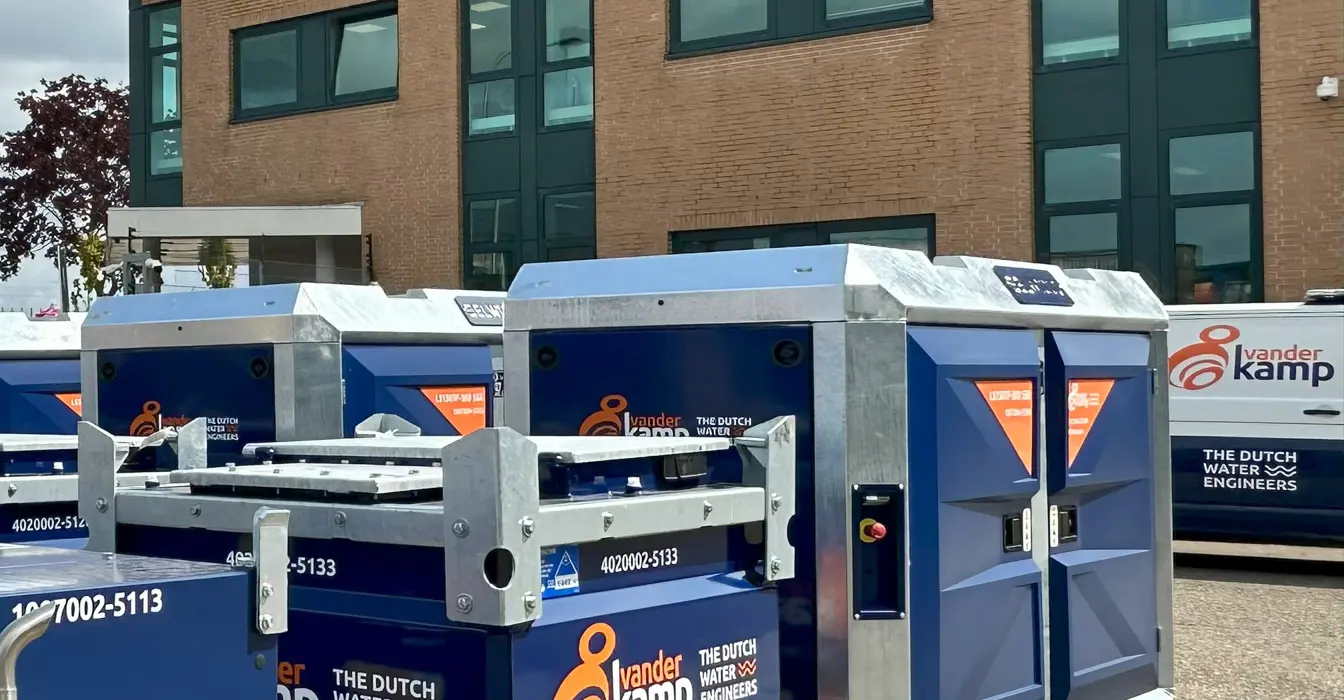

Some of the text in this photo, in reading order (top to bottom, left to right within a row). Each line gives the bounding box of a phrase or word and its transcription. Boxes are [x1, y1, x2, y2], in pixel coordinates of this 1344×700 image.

[462, 303, 504, 319] SELW
[1245, 344, 1324, 361] vander
[1234, 344, 1335, 387] kamp
[631, 412, 682, 428] vander
[696, 416, 752, 427] THE DUTCH
[697, 426, 731, 437] WATER
[1202, 449, 1297, 463] THE DUTCH
[1203, 462, 1260, 475] WATER
[1203, 476, 1297, 491] ENGINEERS
[11, 515, 89, 533] 4020002-512
[601, 547, 678, 574] 4020002-5133
[12, 588, 163, 624] 17002-5113
[699, 638, 757, 666] THE DUTCH
[620, 649, 683, 690] vander
[700, 664, 736, 688] WATER
[332, 668, 368, 690] THE
[372, 674, 436, 700] DUTCH
